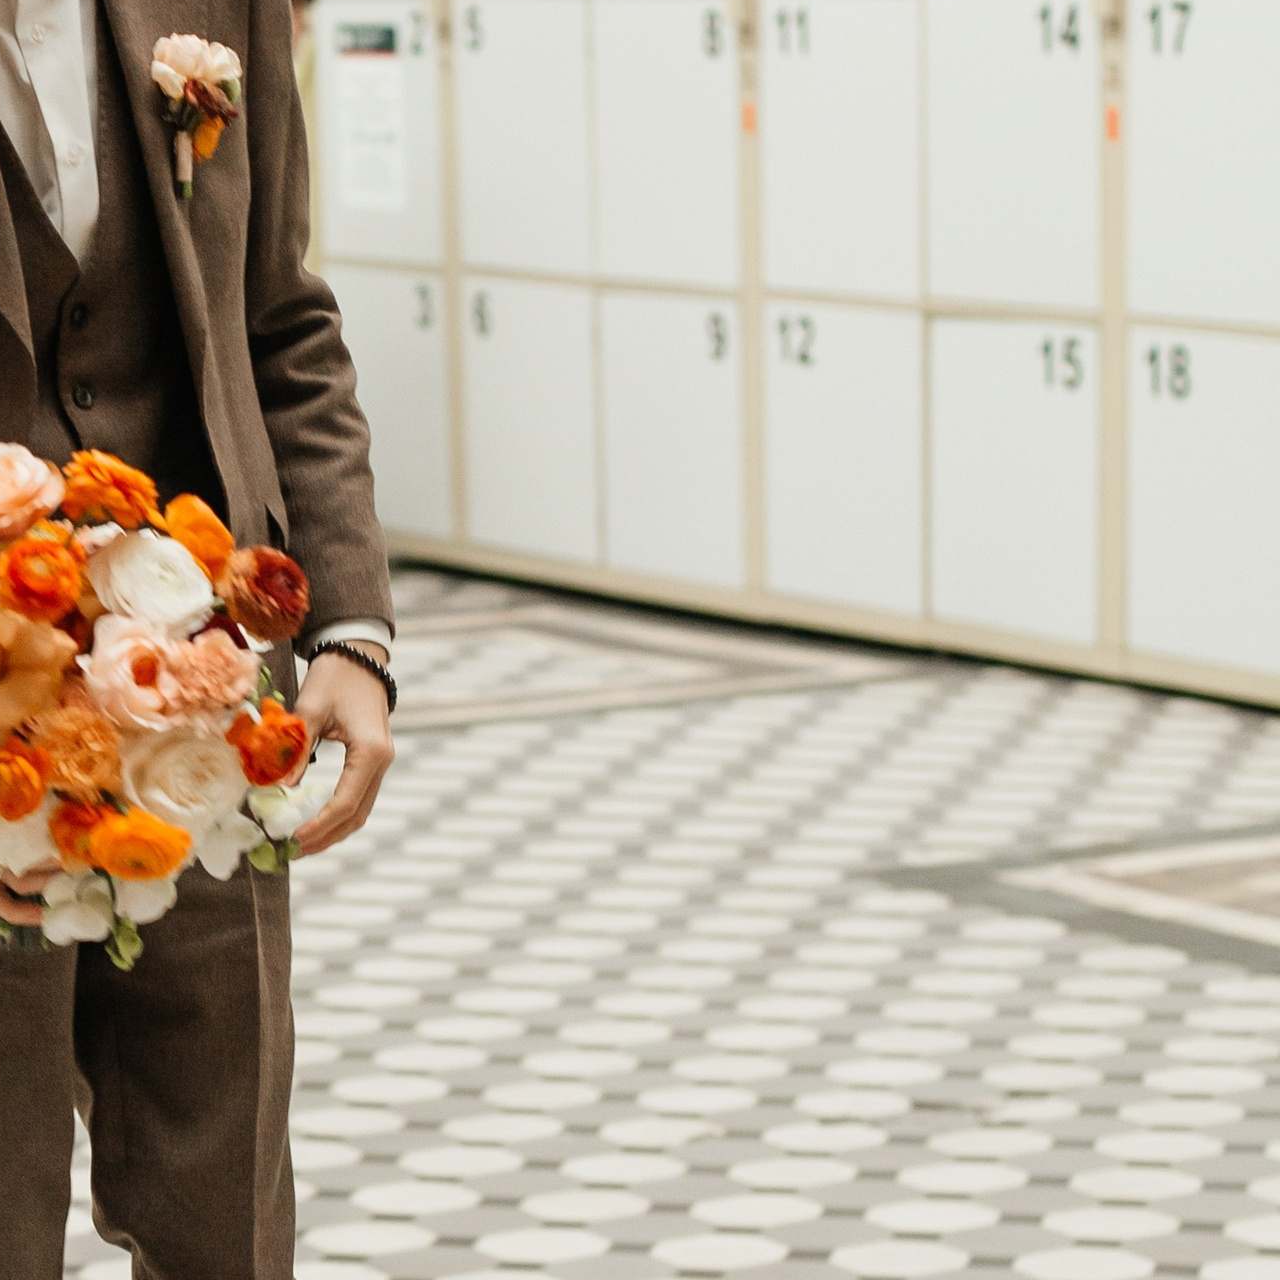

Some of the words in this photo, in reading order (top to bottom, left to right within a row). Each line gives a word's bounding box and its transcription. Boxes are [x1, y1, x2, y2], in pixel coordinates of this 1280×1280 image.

[463, 5, 483, 52] 5
[775, 8, 809, 50] 11
[1039, 6, 1080, 50] 14
[1147, 0, 1192, 50] 17
[416, 284, 434, 330] 3
[471, 291, 490, 337] 6
[709, 313, 728, 361] 9
[778, 317, 813, 366] 12
[1040, 337, 1083, 390] 15
[1146, 345, 1191, 400] 18
